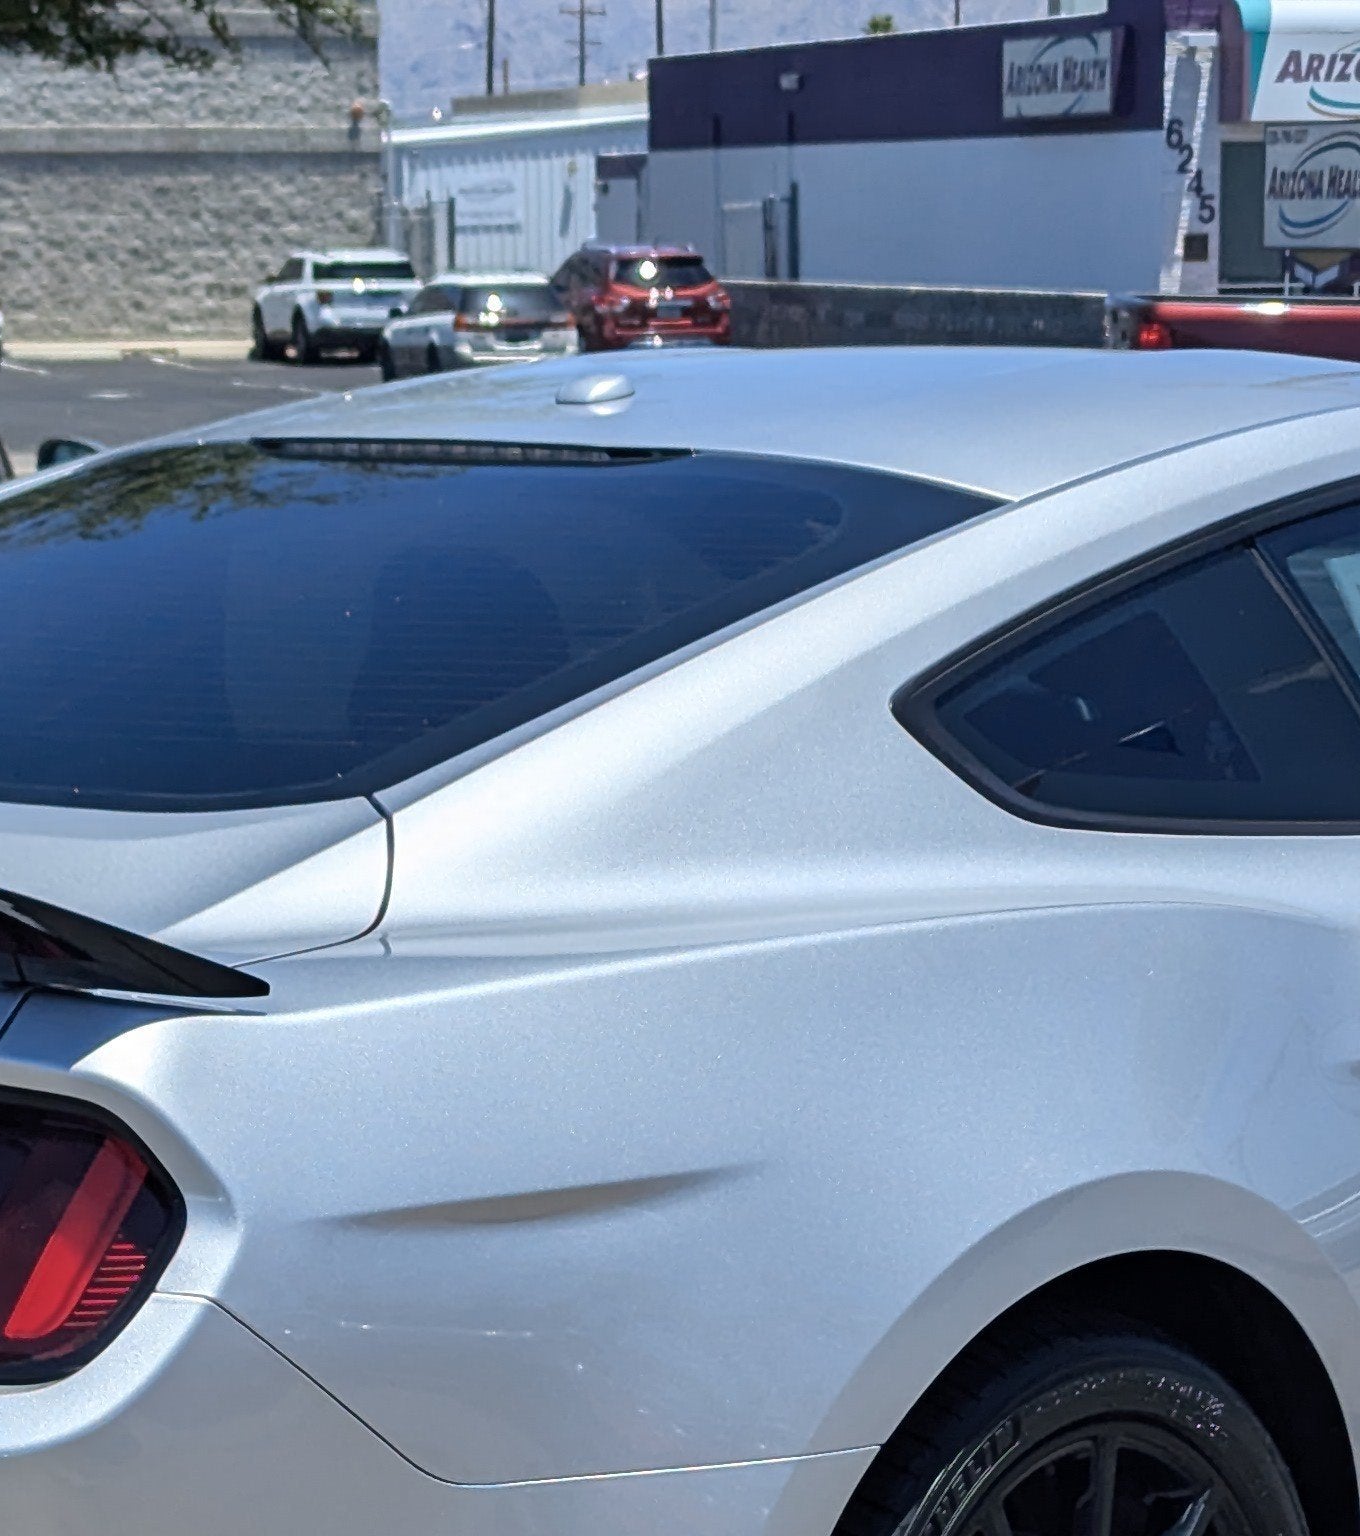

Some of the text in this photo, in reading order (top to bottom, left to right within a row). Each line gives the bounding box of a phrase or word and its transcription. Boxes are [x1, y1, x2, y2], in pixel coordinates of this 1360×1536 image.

[1007, 56, 1109, 97] ARIZONA HEALTH
[1165, 118, 1216, 224] 6245
[1268, 166, 1324, 200] ARIZONA
